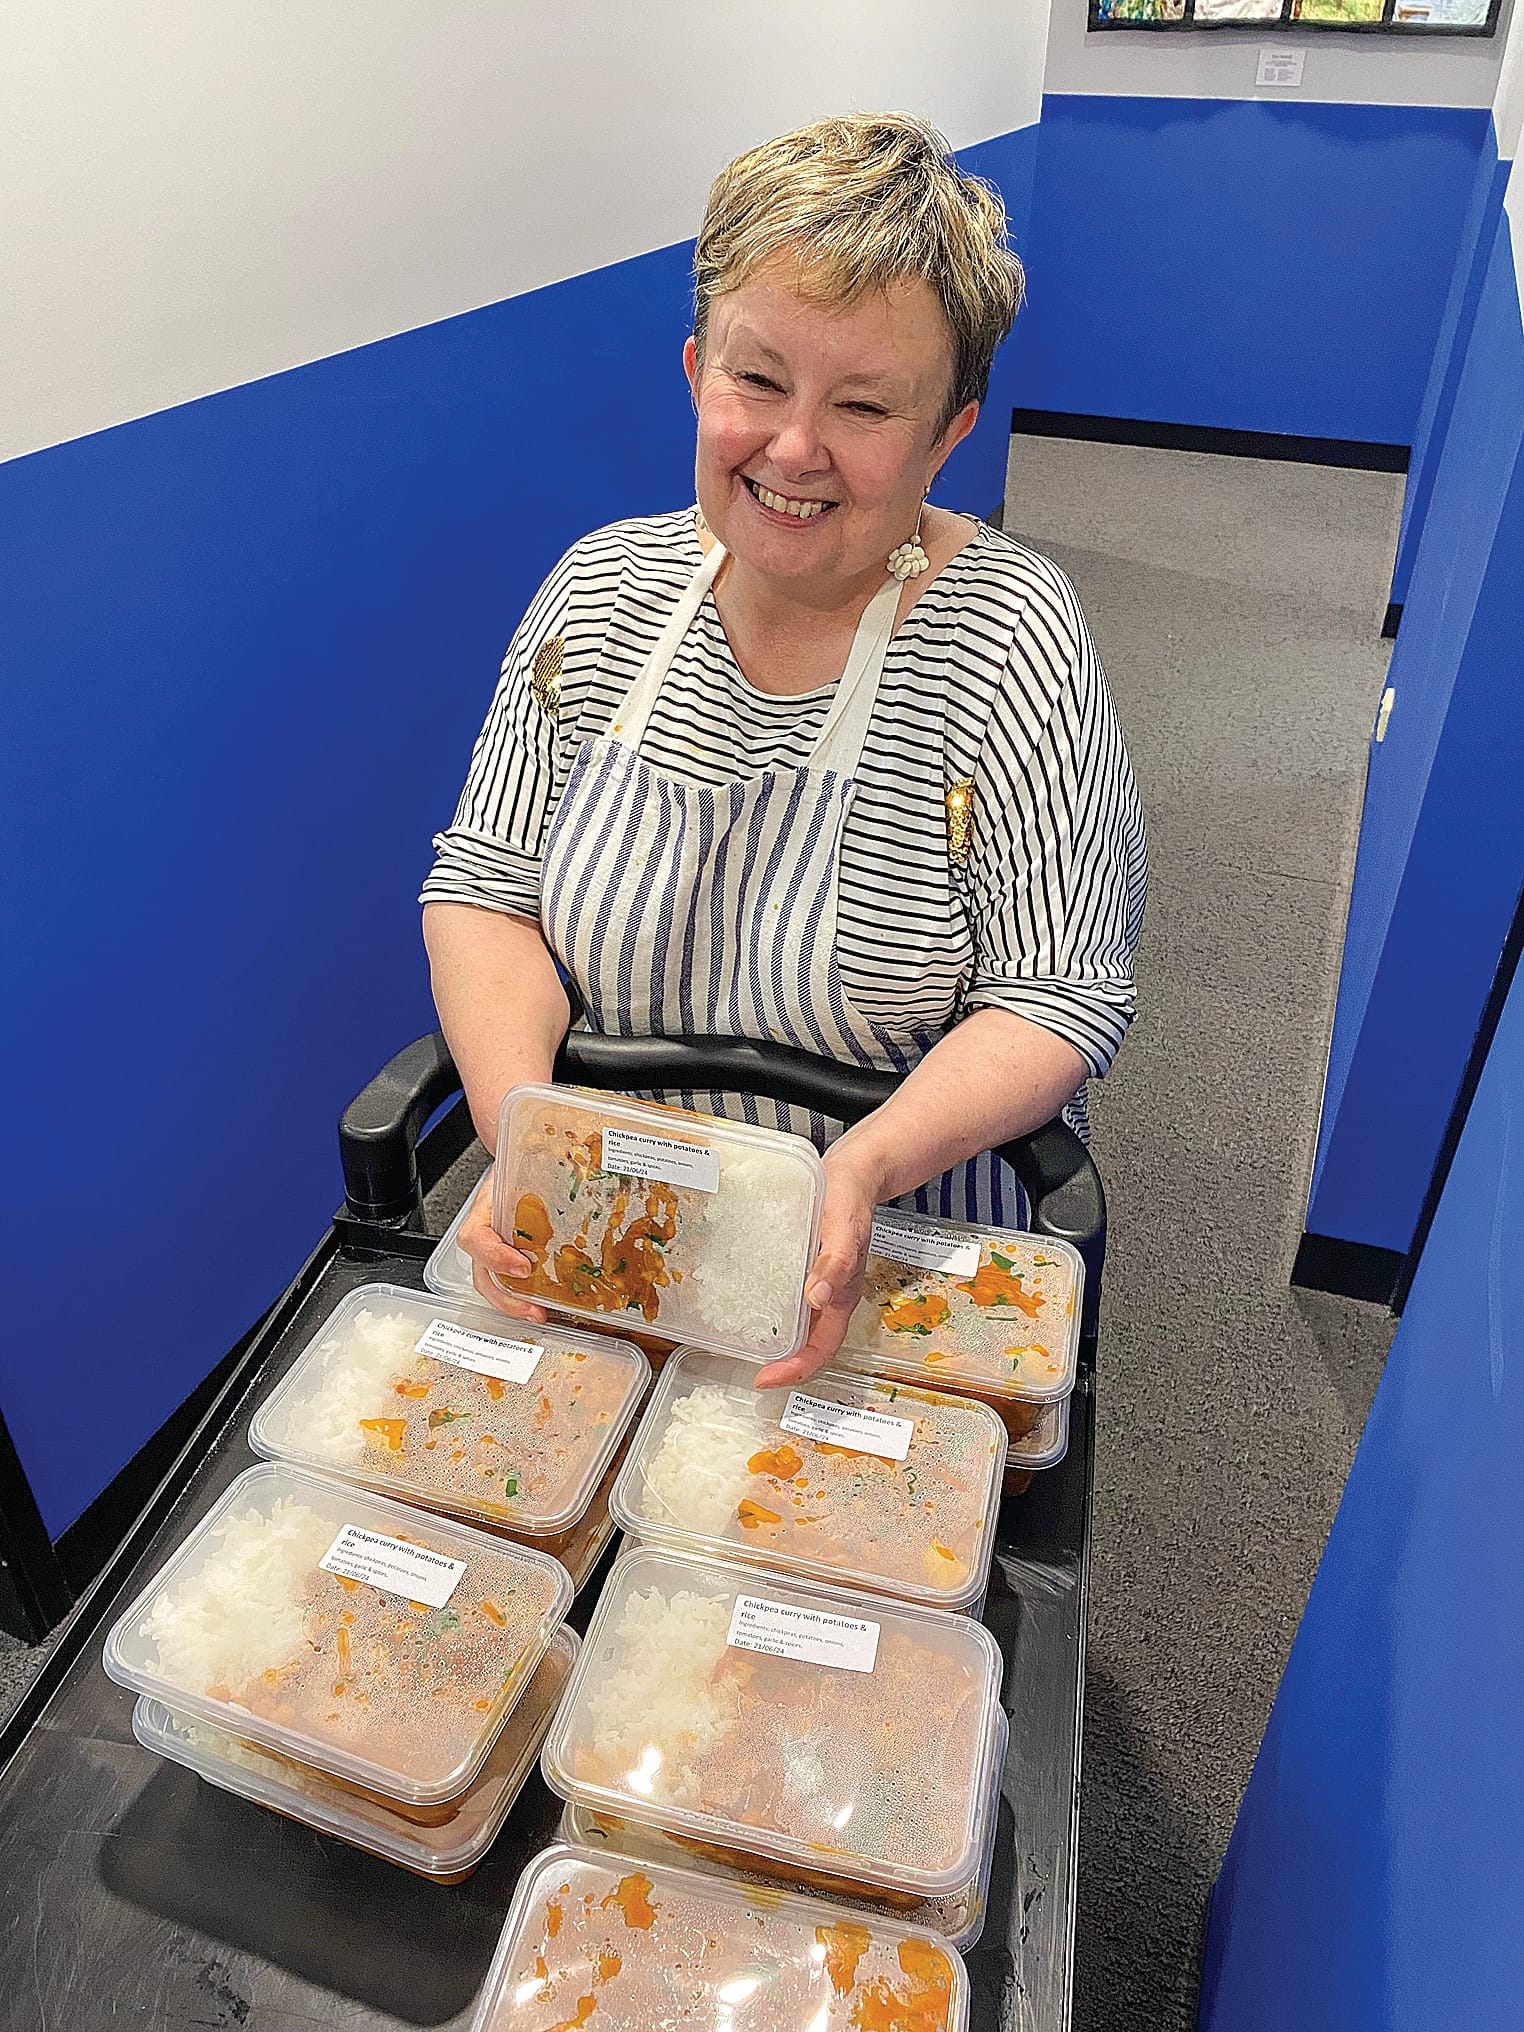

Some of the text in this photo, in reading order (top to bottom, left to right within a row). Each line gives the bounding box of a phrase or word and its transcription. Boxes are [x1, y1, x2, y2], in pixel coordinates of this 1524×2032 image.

[608, 1130, 637, 1141] Chickpea
[674, 1144, 702, 1154] potatoes
[437, 1324, 465, 1335] Chickpea
[466, 1332, 482, 1341] curry
[499, 1342, 526, 1352] potatoes
[795, 1396, 825, 1409] Chickpea
[827, 1406, 845, 1415] curry
[863, 1415, 894, 1426] potatoes
[341, 1540, 355, 1548] rice
[348, 1530, 379, 1544] Chickpea
[380, 1540, 398, 1550] curry
[399, 1546, 415, 1556] with
[415, 1552, 447, 1567] potatoes
[342, 1568, 369, 1581] 21/06/24
[741, 1612, 756, 1620] rice
[744, 1601, 866, 1632] Chickpea curry with potatoes &
[771, 1628, 797, 1638] chickpeas,
[799, 1634, 824, 1643] potatoes,
[735, 1639, 784, 1654] Date: 21/06/24
